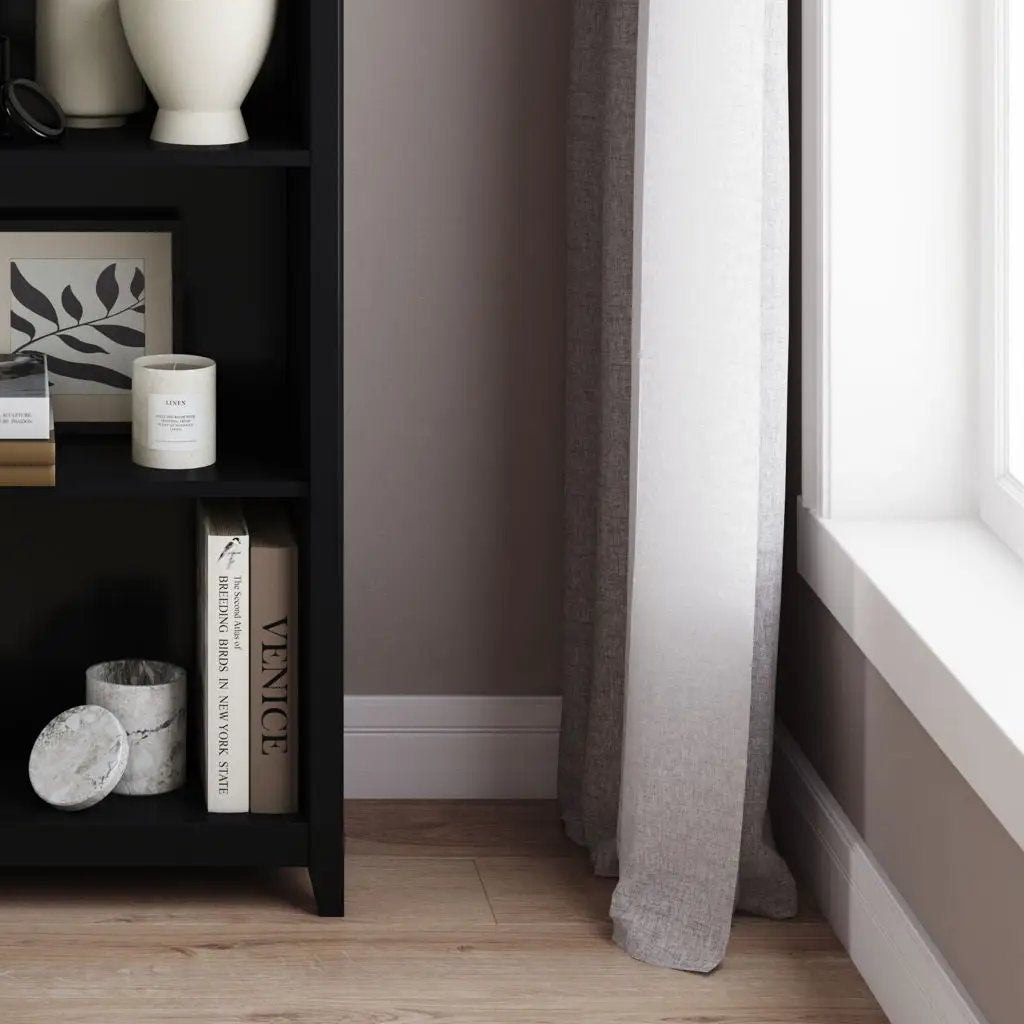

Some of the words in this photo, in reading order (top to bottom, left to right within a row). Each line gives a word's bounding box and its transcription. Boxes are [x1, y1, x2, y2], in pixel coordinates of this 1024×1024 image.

[234, 576, 242, 590] The
[218, 575, 229, 634] BREEDING
[234, 591, 242, 619] Second
[234, 621, 242, 640] Atlas
[218, 638, 229, 673] BIRDS
[234, 641, 242, 651] of
[218, 678, 229, 690] IN
[261, 615, 289, 756] VENICE
[218, 695, 229, 721] NEW
[218, 724, 229, 756] YORK
[218, 761, 229, 795] STATE
